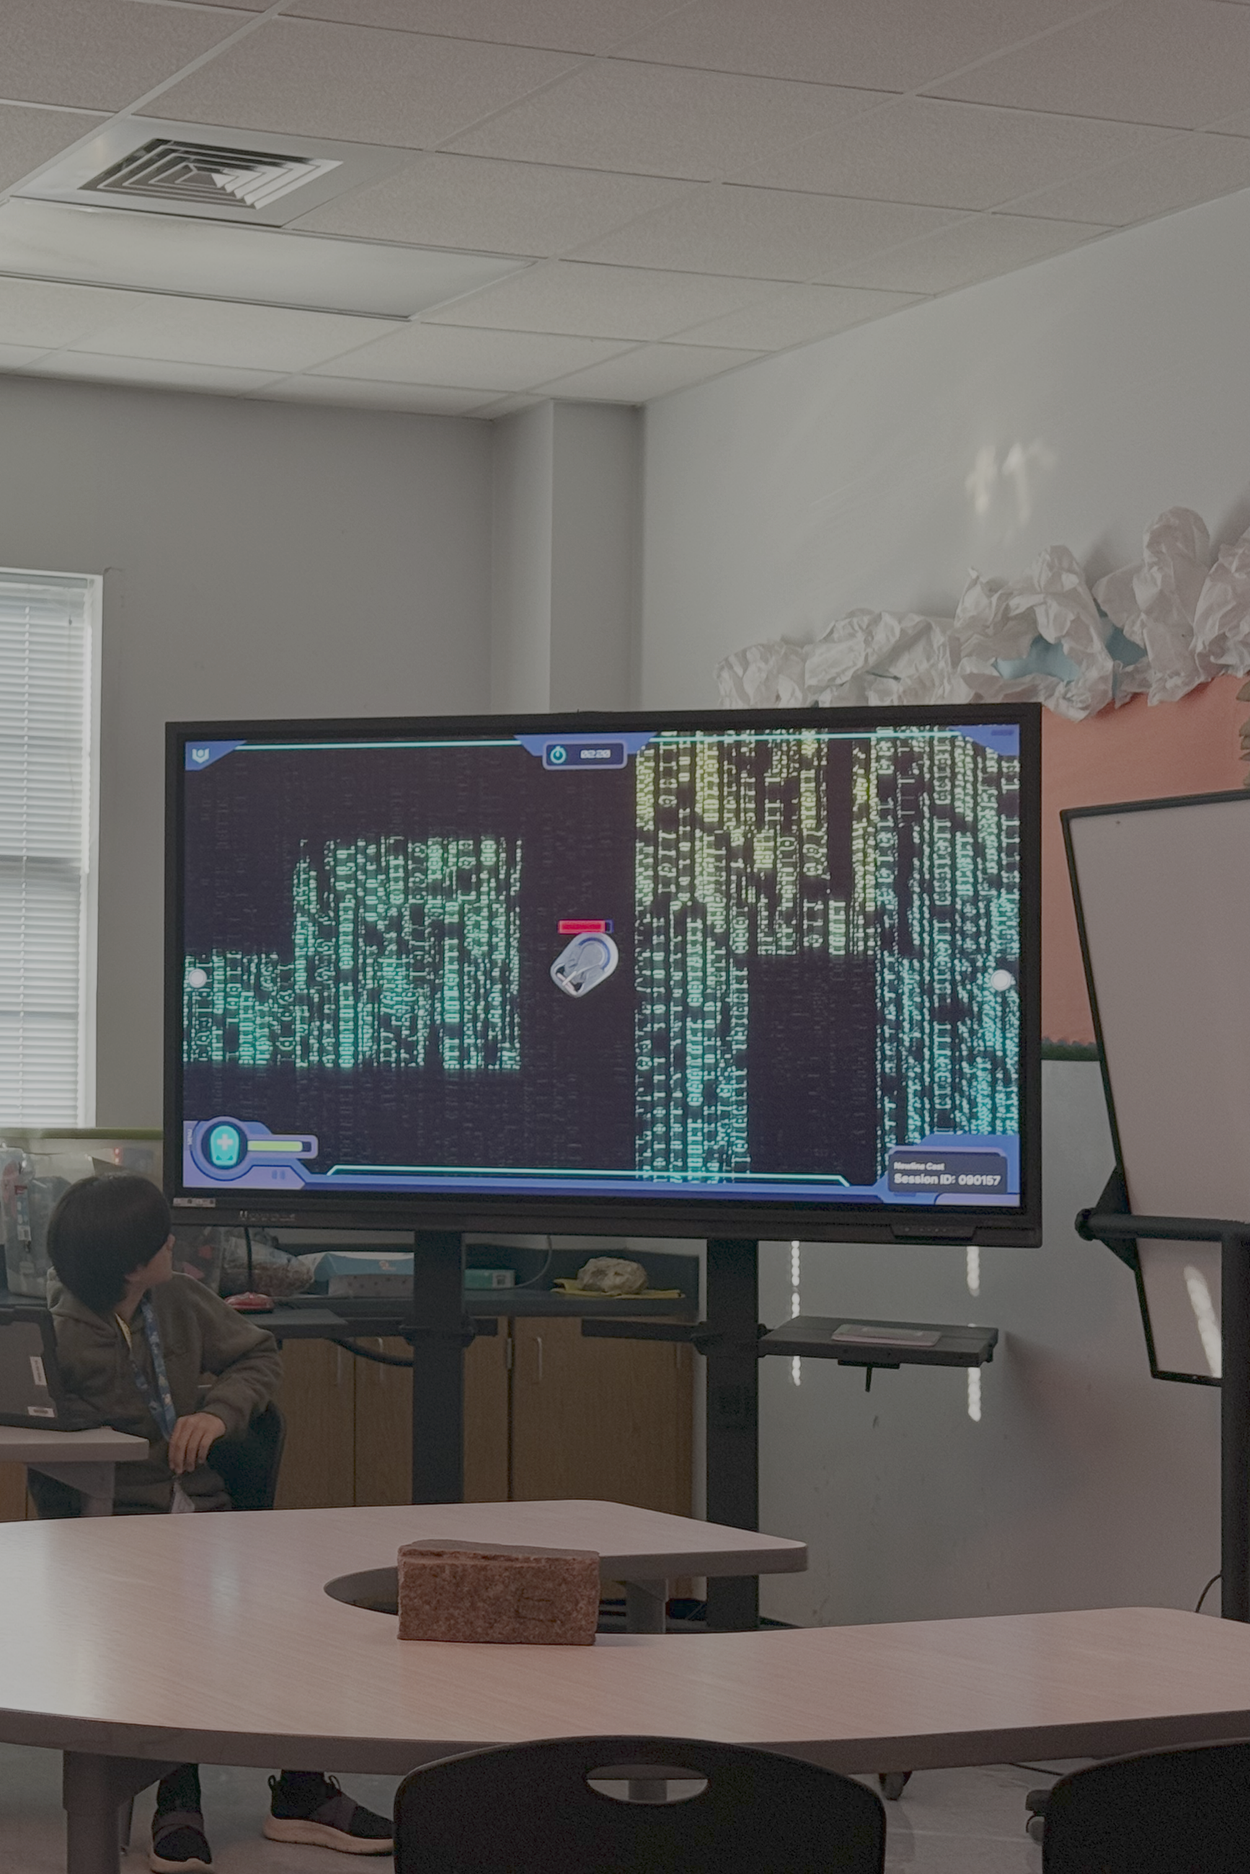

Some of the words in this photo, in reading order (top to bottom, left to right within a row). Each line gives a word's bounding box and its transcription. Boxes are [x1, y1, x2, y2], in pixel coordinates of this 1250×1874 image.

[893, 1161, 926, 1170] Newline
[926, 1162, 945, 1171] Cast
[894, 1173, 938, 1184] Session
[939, 1174, 956, 1185] ID:
[958, 1175, 1001, 1186] 090157
